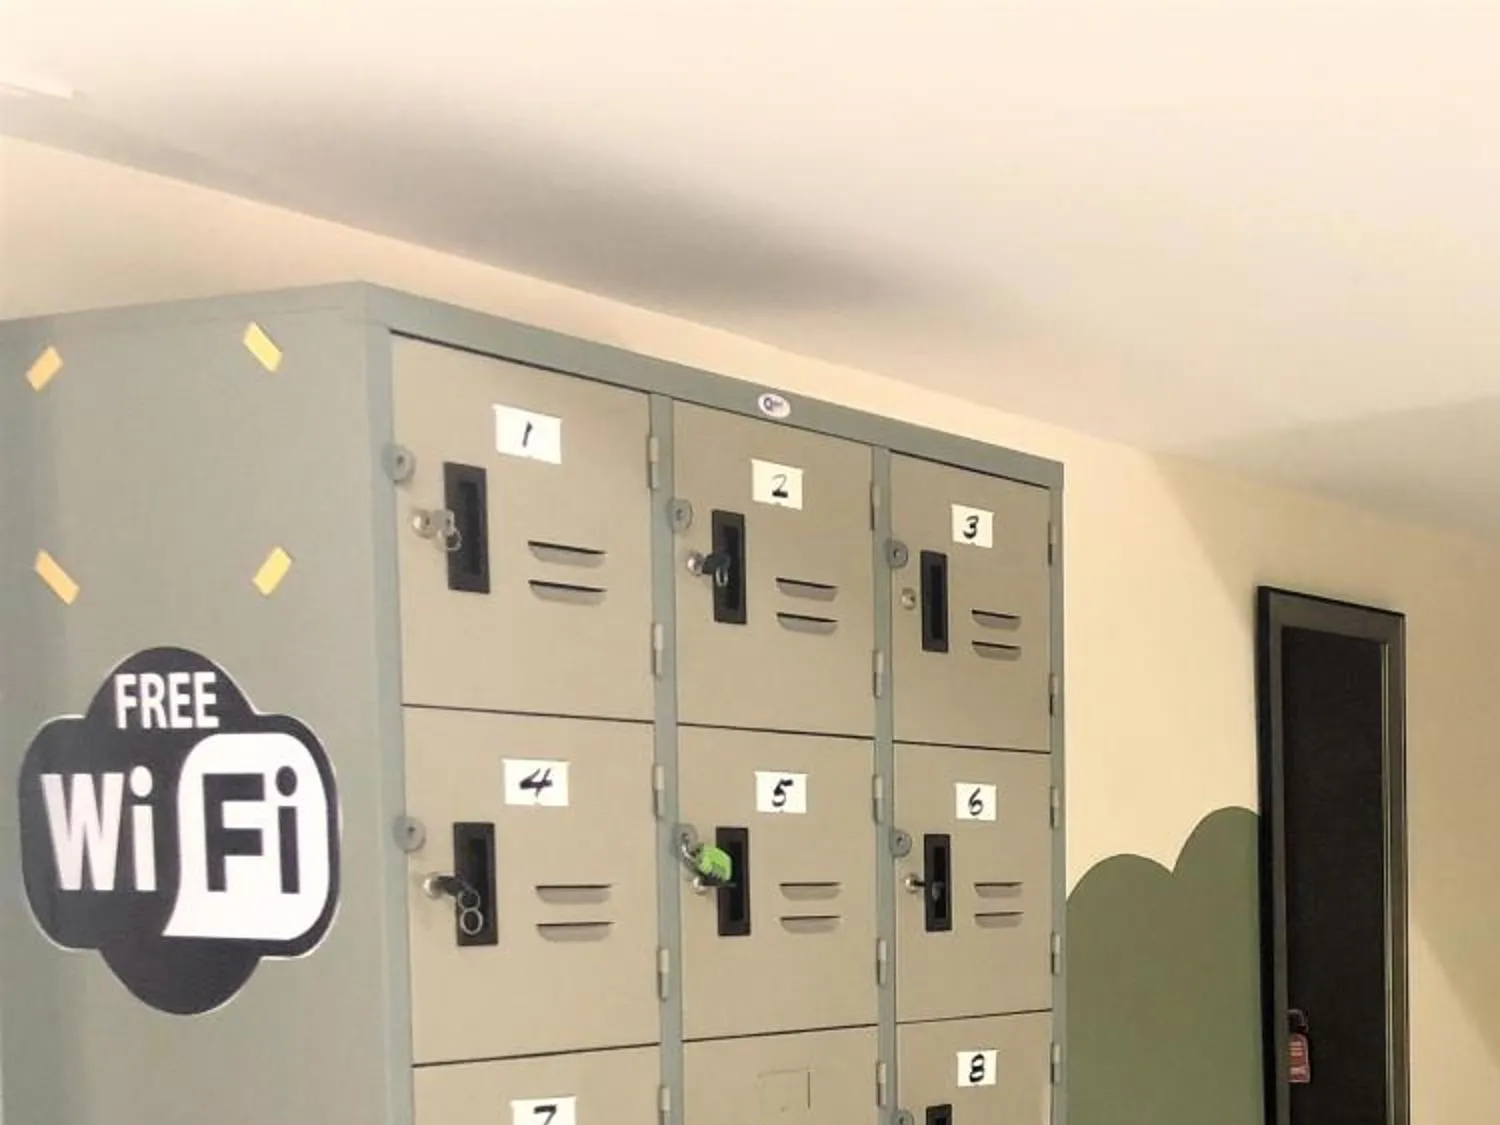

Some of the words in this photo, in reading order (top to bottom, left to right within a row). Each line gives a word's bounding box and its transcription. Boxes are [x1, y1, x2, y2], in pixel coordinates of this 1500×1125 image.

[771, 473, 789, 499] 2
[962, 515, 980, 540] 3
[115, 671, 220, 729] FREE
[518, 768, 554, 797] 4
[771, 779, 795, 808] 5
[967, 787, 984, 817] 6
[40, 765, 157, 892] Wi
[202, 765, 301, 894] Fi
[968, 1053, 985, 1084] 8
